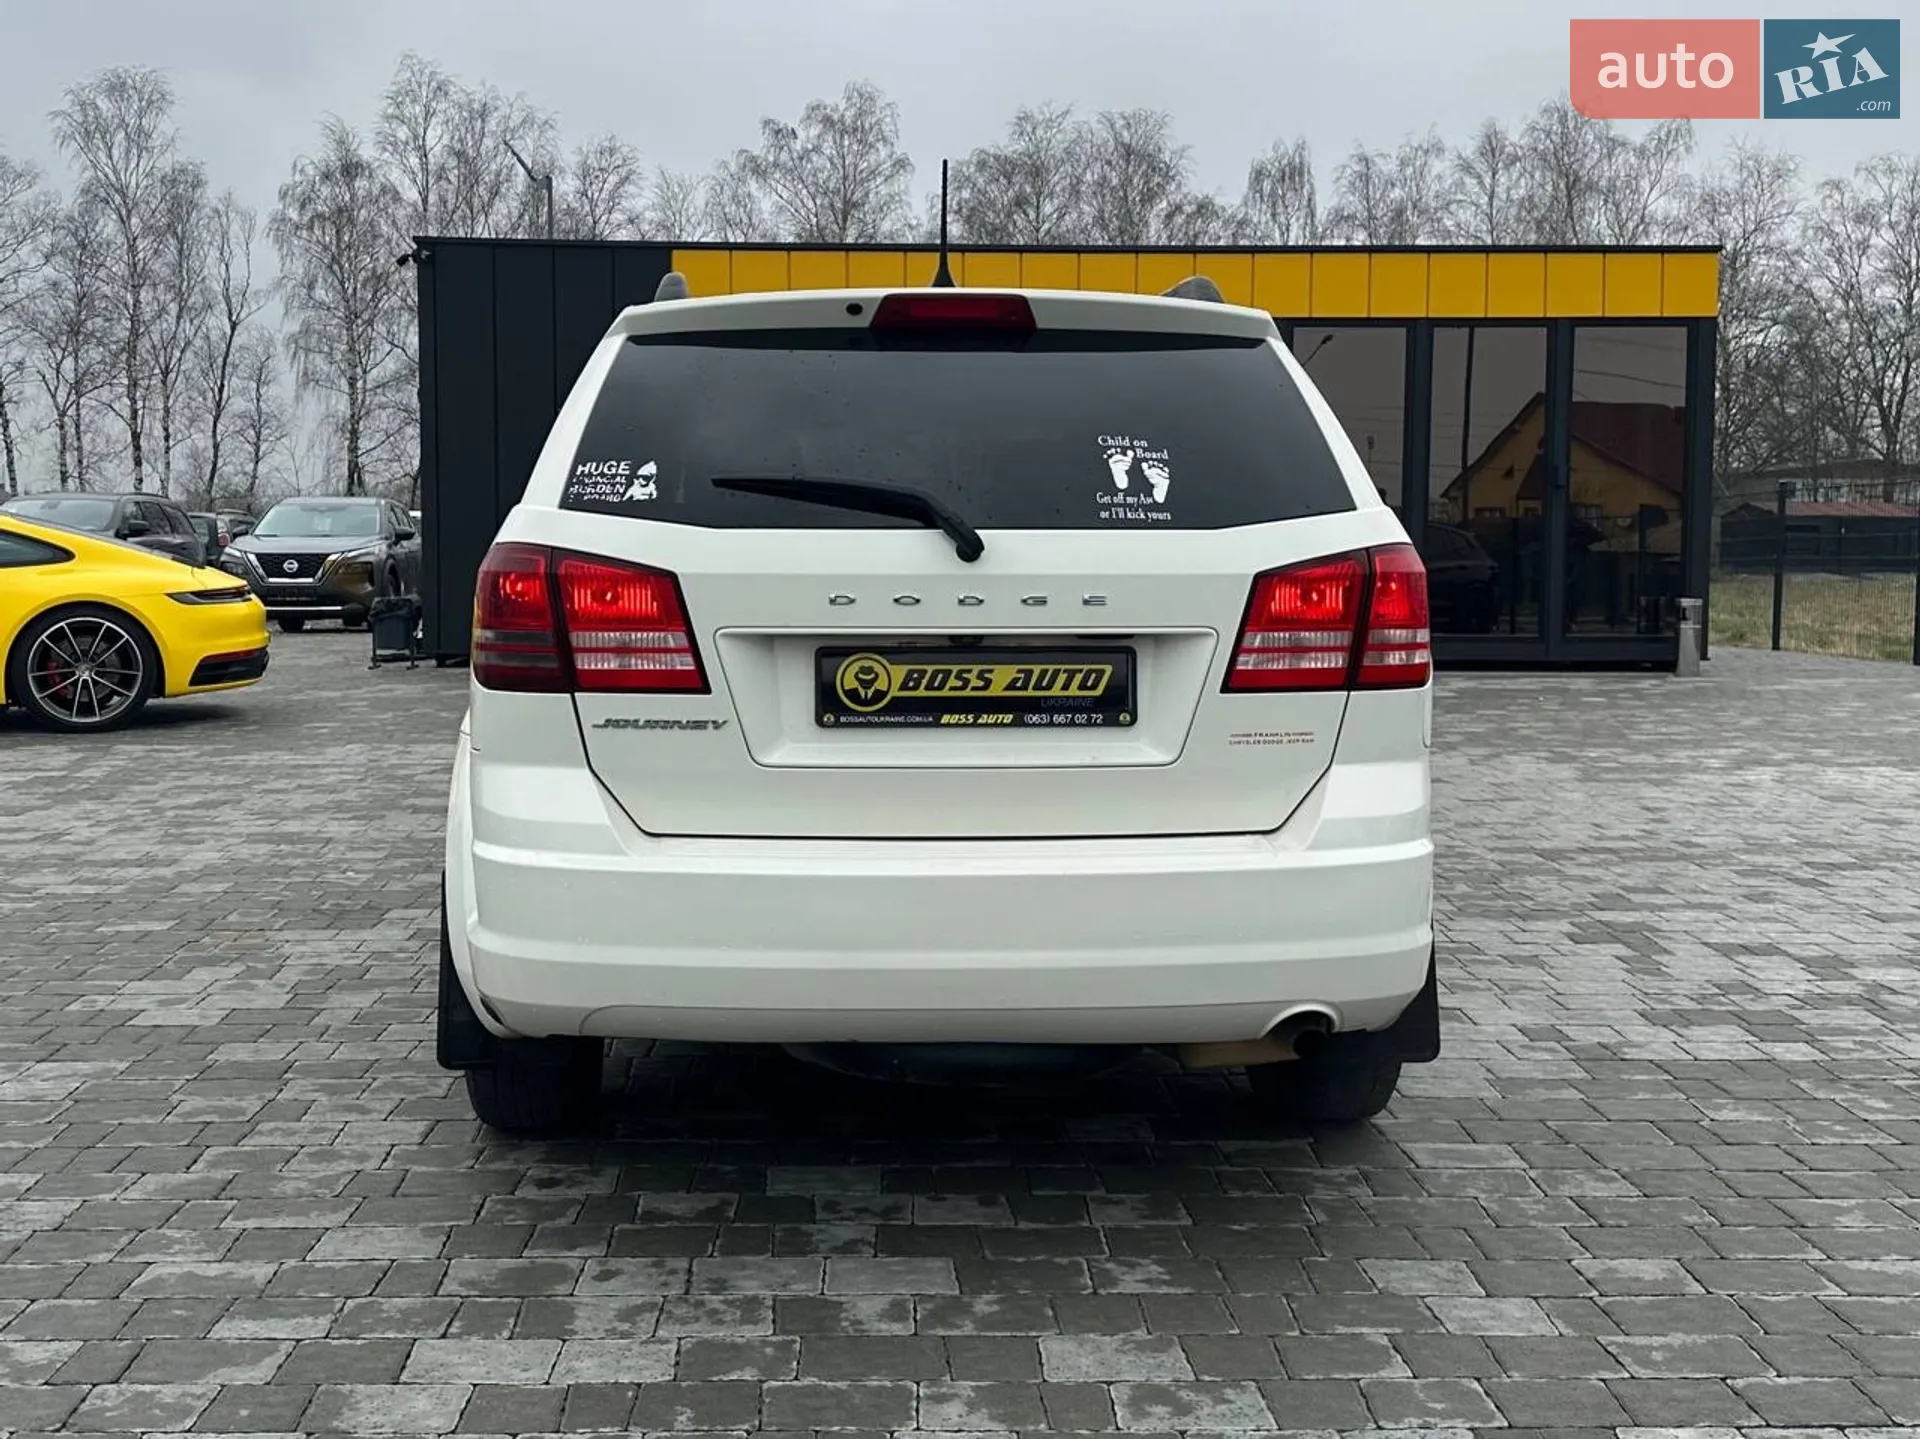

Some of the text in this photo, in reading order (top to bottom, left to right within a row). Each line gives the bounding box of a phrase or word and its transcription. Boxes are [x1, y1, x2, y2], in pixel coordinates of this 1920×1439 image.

[1097, 435, 1130, 446] Child
[1135, 448, 1169, 459] Board
[576, 461, 631, 475] HUGE
[1096, 492, 1112, 504] Get
[1126, 507, 1146, 519] kick
[1147, 511, 1171, 522] yours
[828, 594, 1107, 606] DODGE
[898, 668, 1107, 692] BOSS AUTO
[591, 718, 728, 730] JOURNEY
[940, 713, 1014, 725] BOSS AUTO
[1024, 713, 1104, 725] (063) 667 02 72
